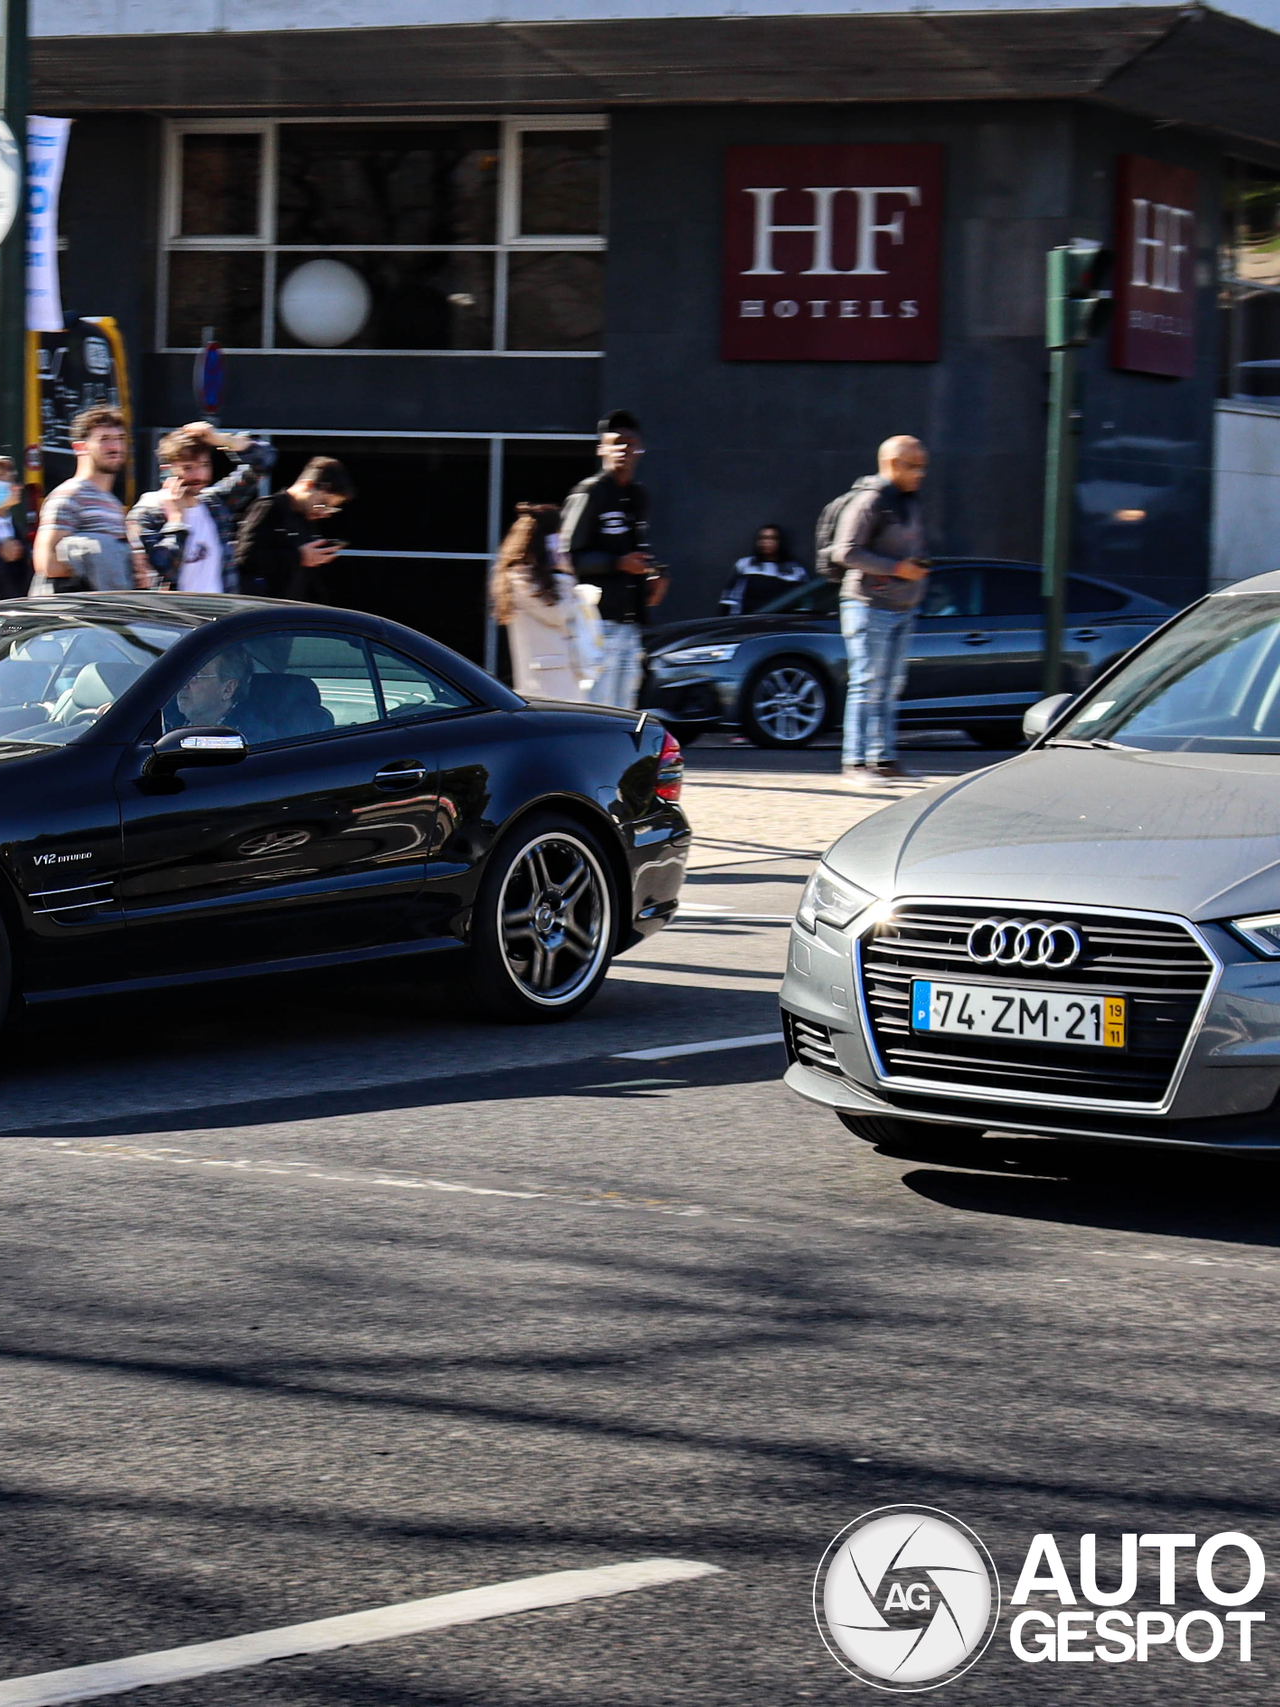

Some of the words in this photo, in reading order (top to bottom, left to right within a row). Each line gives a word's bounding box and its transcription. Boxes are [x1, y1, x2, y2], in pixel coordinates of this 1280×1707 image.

[739, 186, 922, 275] HF
[1130, 198, 1195, 293] HF
[739, 299, 920, 319] HOTELS
[33, 853, 57, 866] V12
[918, 1009, 926, 1021] P
[1109, 1004, 1123, 1018] 19
[1110, 1030, 1121, 1044] 11
